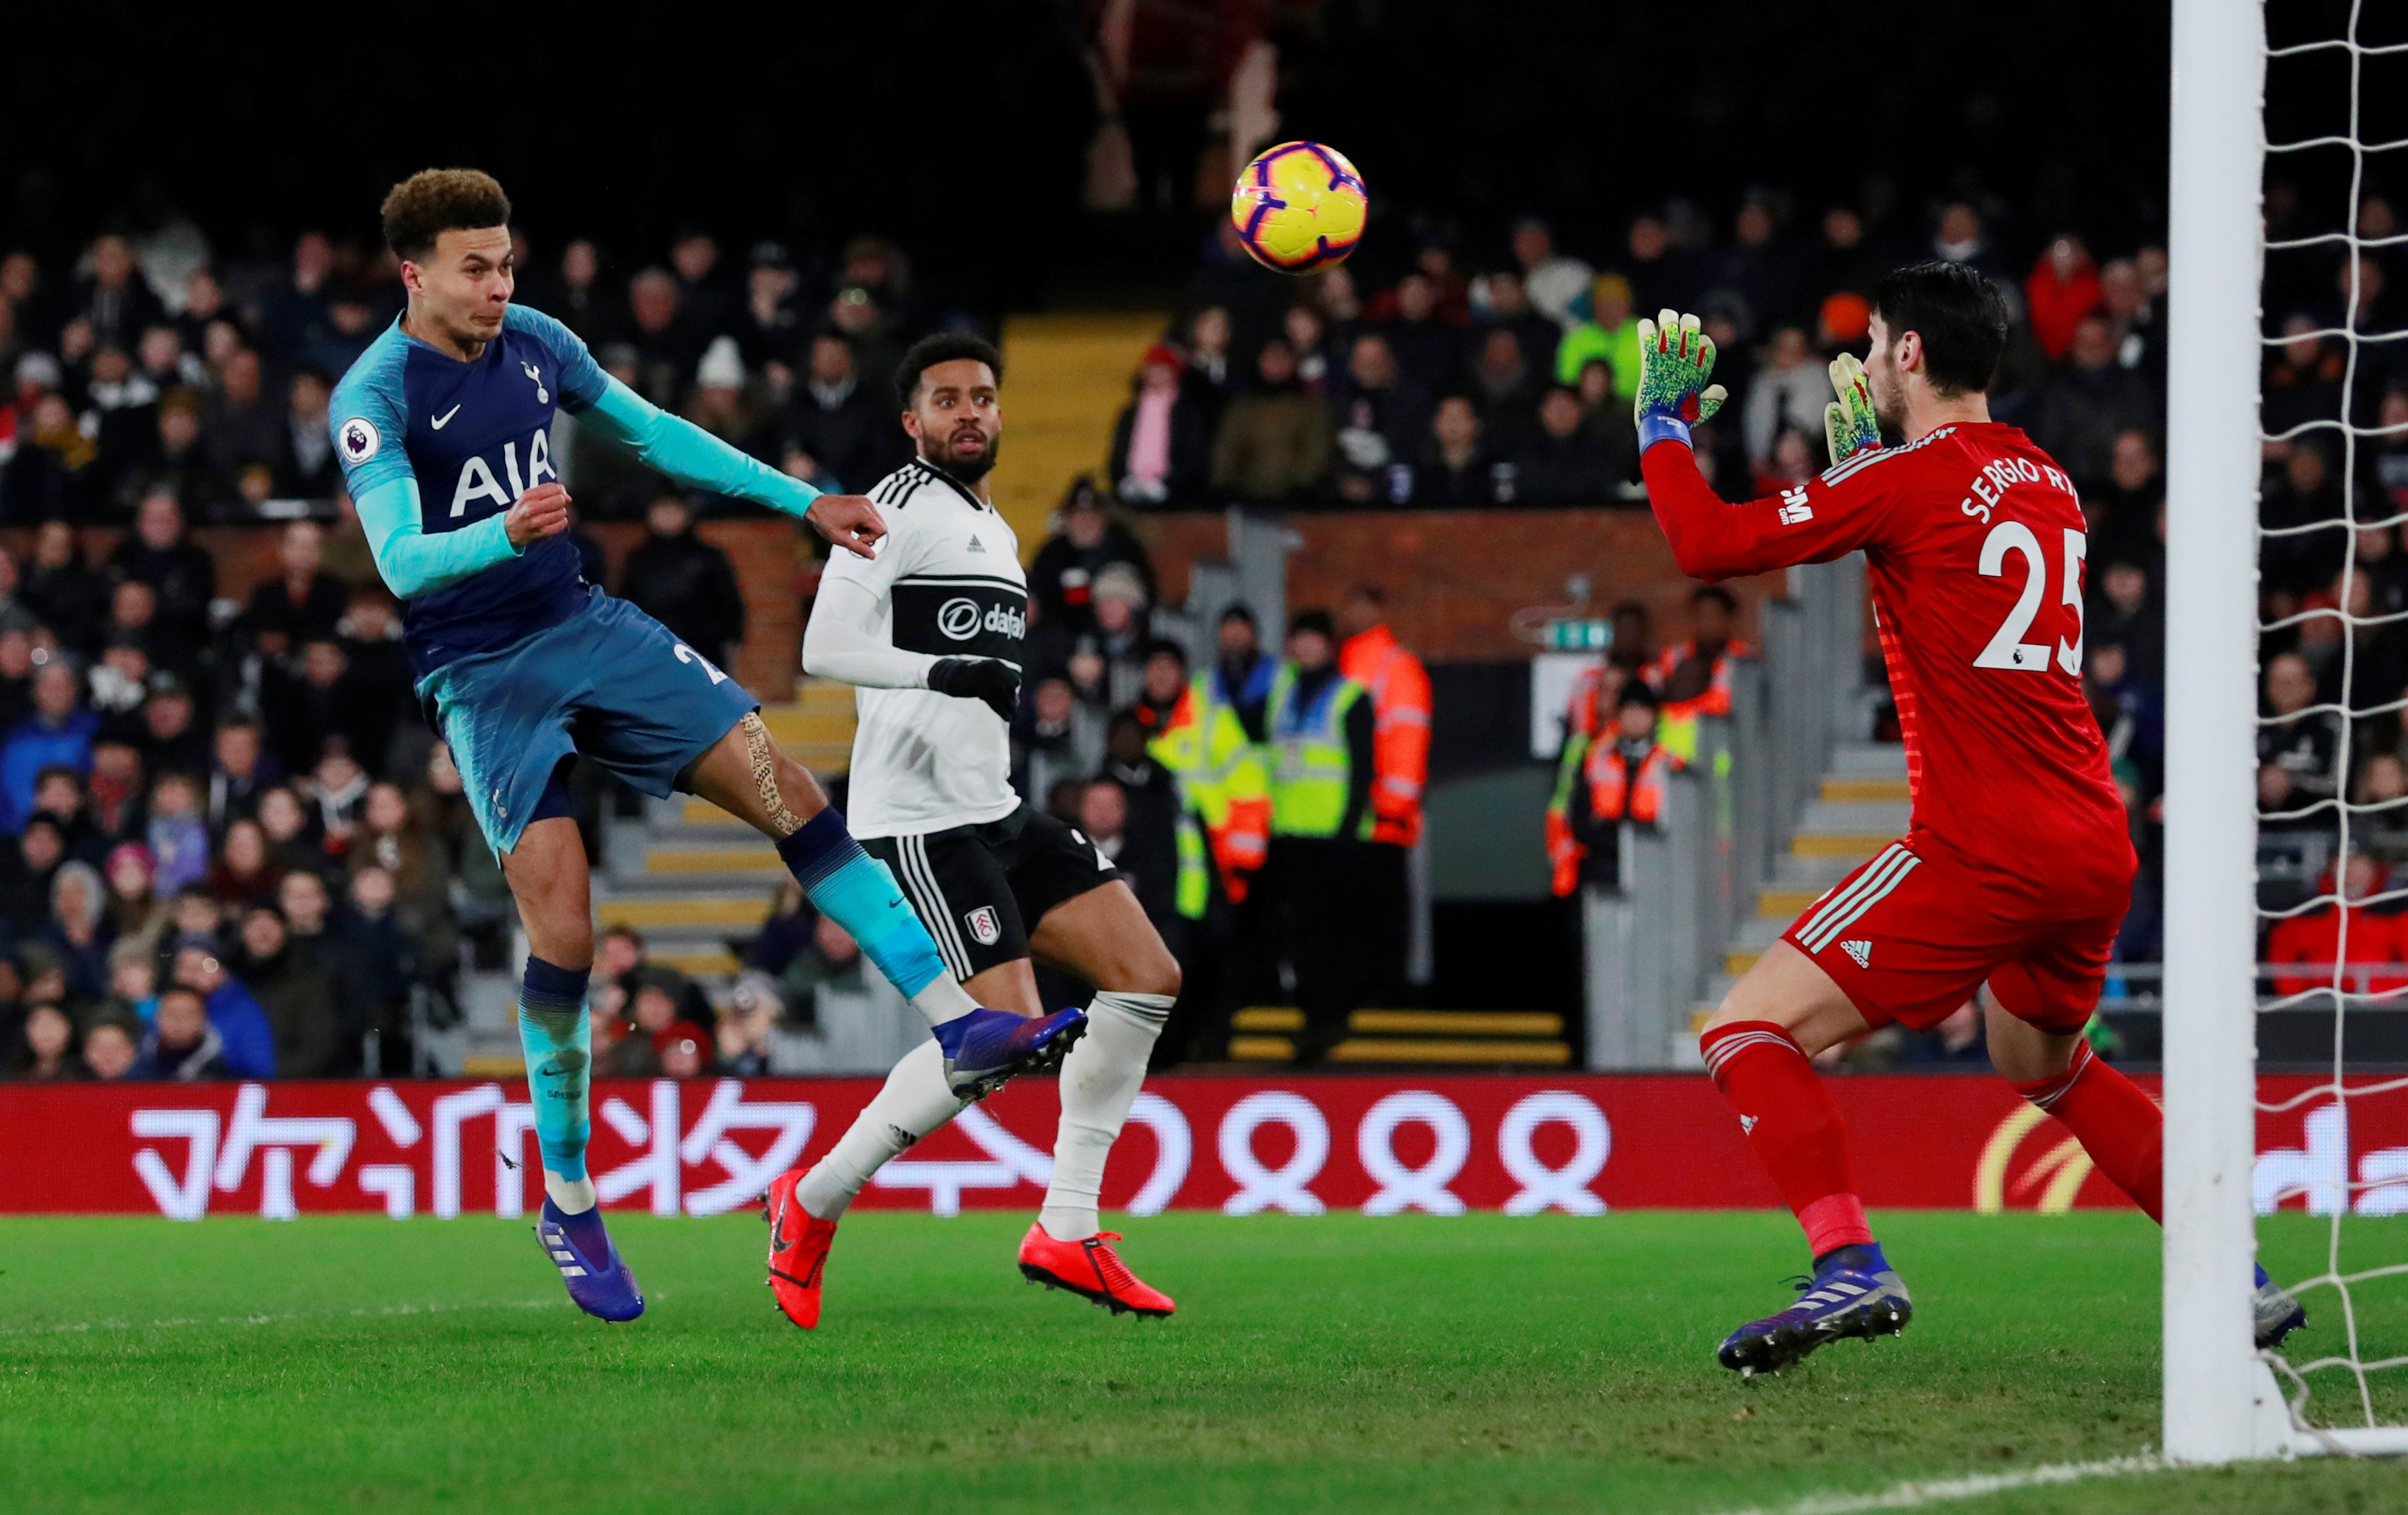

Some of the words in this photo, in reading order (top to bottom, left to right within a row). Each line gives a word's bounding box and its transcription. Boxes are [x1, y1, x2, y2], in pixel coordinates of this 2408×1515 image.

[450, 428, 556, 517] AIA
[1961, 457, 2040, 524] SERGIO
[1973, 520, 2087, 676] 25
[1840, 941, 1869, 969] adidas
